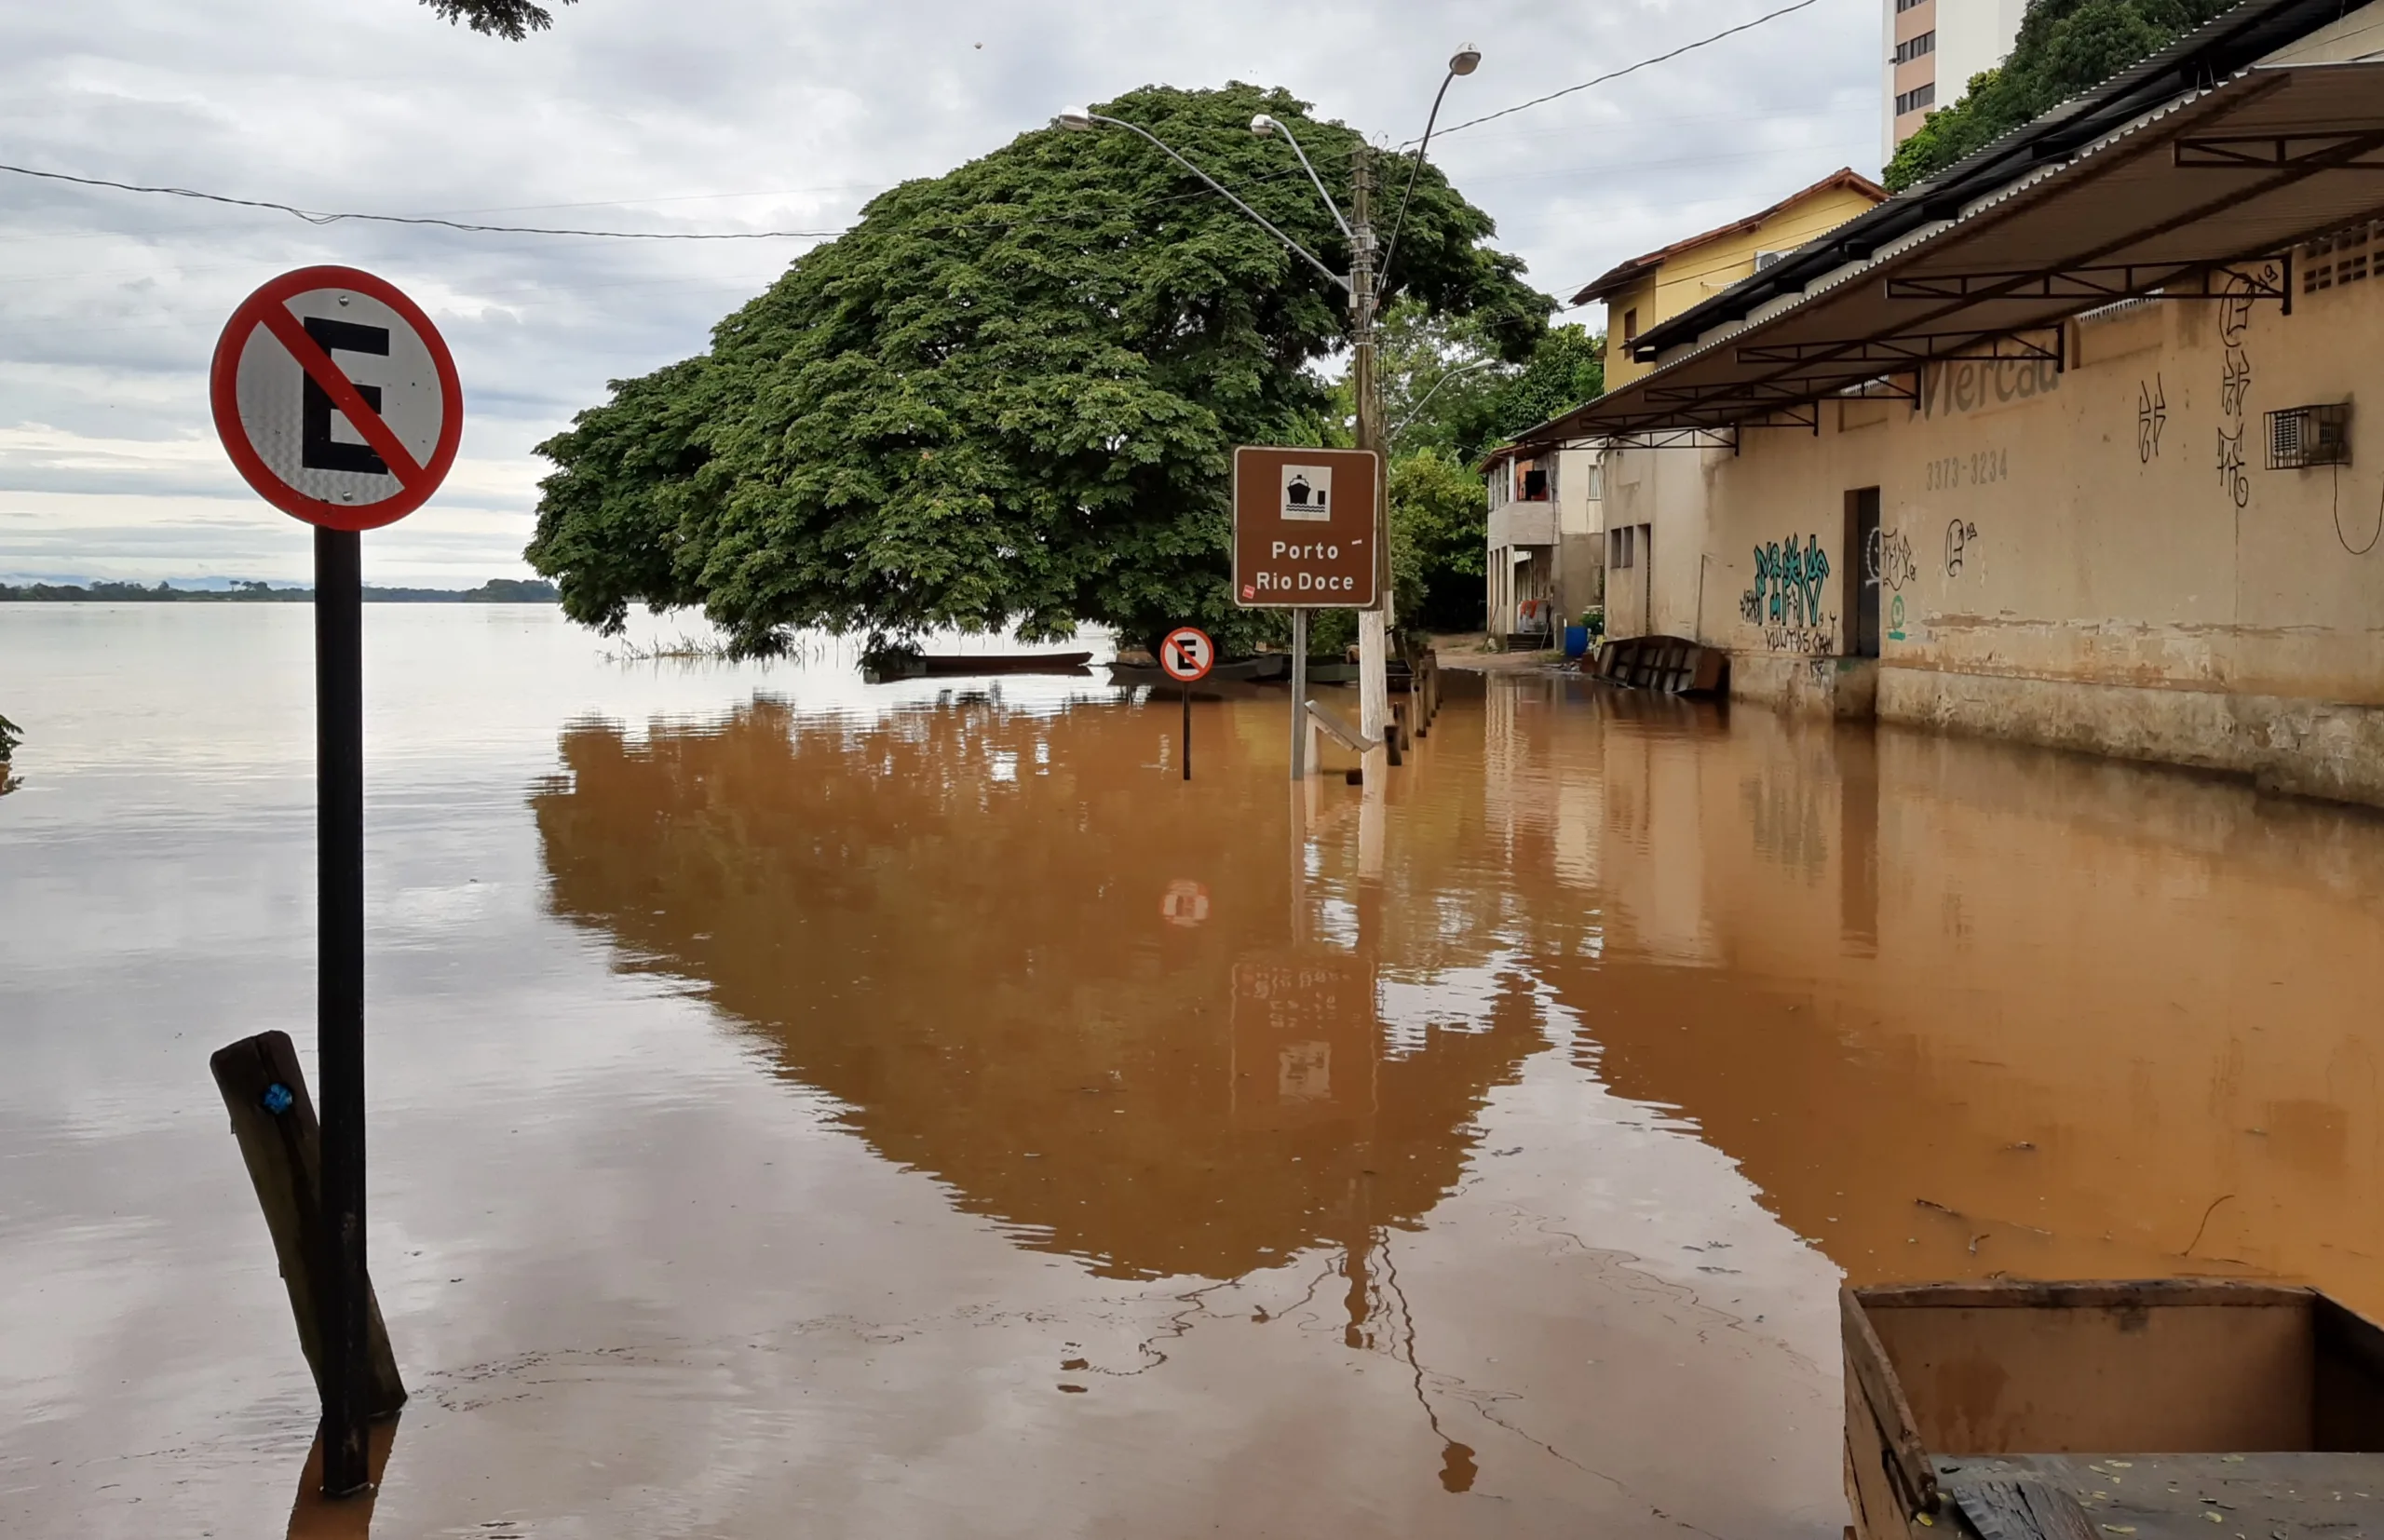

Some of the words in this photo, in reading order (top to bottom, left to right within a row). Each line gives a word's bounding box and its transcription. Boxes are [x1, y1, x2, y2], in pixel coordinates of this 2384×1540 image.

[302, 316, 389, 475] E
[1926, 447, 2008, 492] 3373-3234
[1272, 541, 1338, 560] Porto
[1256, 572, 1292, 590] Rio
[1298, 572, 1354, 590] Doce
[1177, 640, 1197, 669] E
